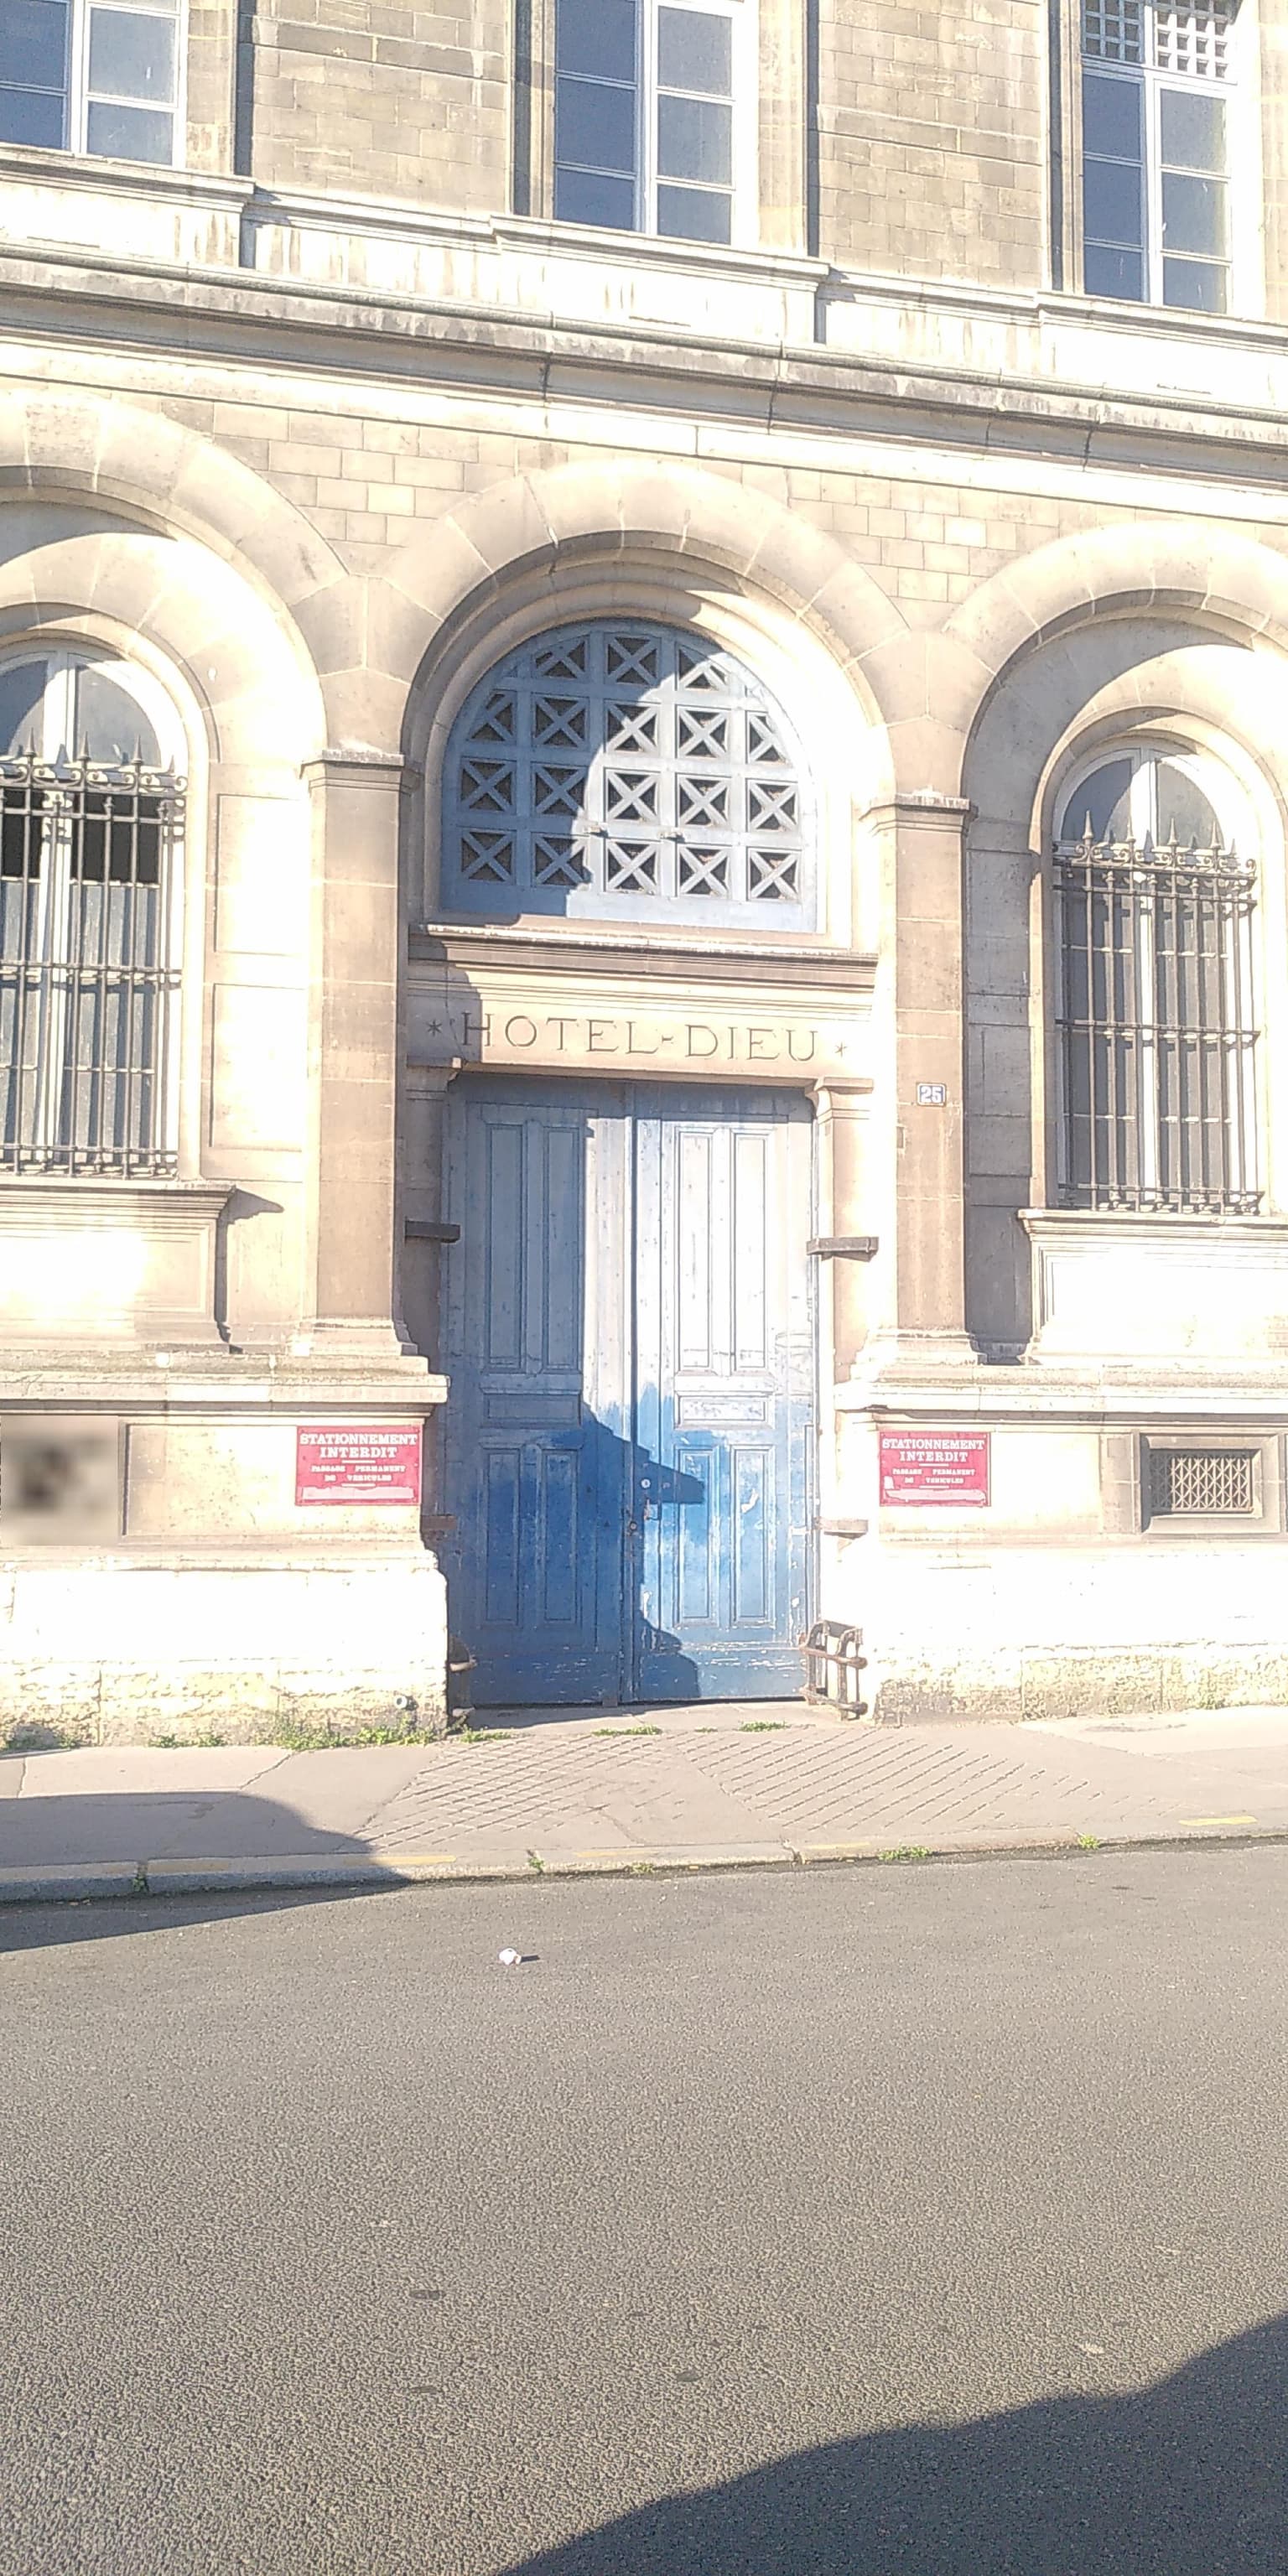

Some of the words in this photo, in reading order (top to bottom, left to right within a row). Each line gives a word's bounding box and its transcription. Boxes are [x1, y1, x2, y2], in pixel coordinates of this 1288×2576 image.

[461, 1012, 819, 1062] HOTEL-DIEU
[921, 1086, 942, 1104] 25
[299, 1433, 418, 1445] STATIONNEMENT
[881, 1438, 985, 1450] STATIONNEMENT
[320, 1446, 397, 1458] INTERDIT
[899, 1451, 968, 1462] INTERDIT
